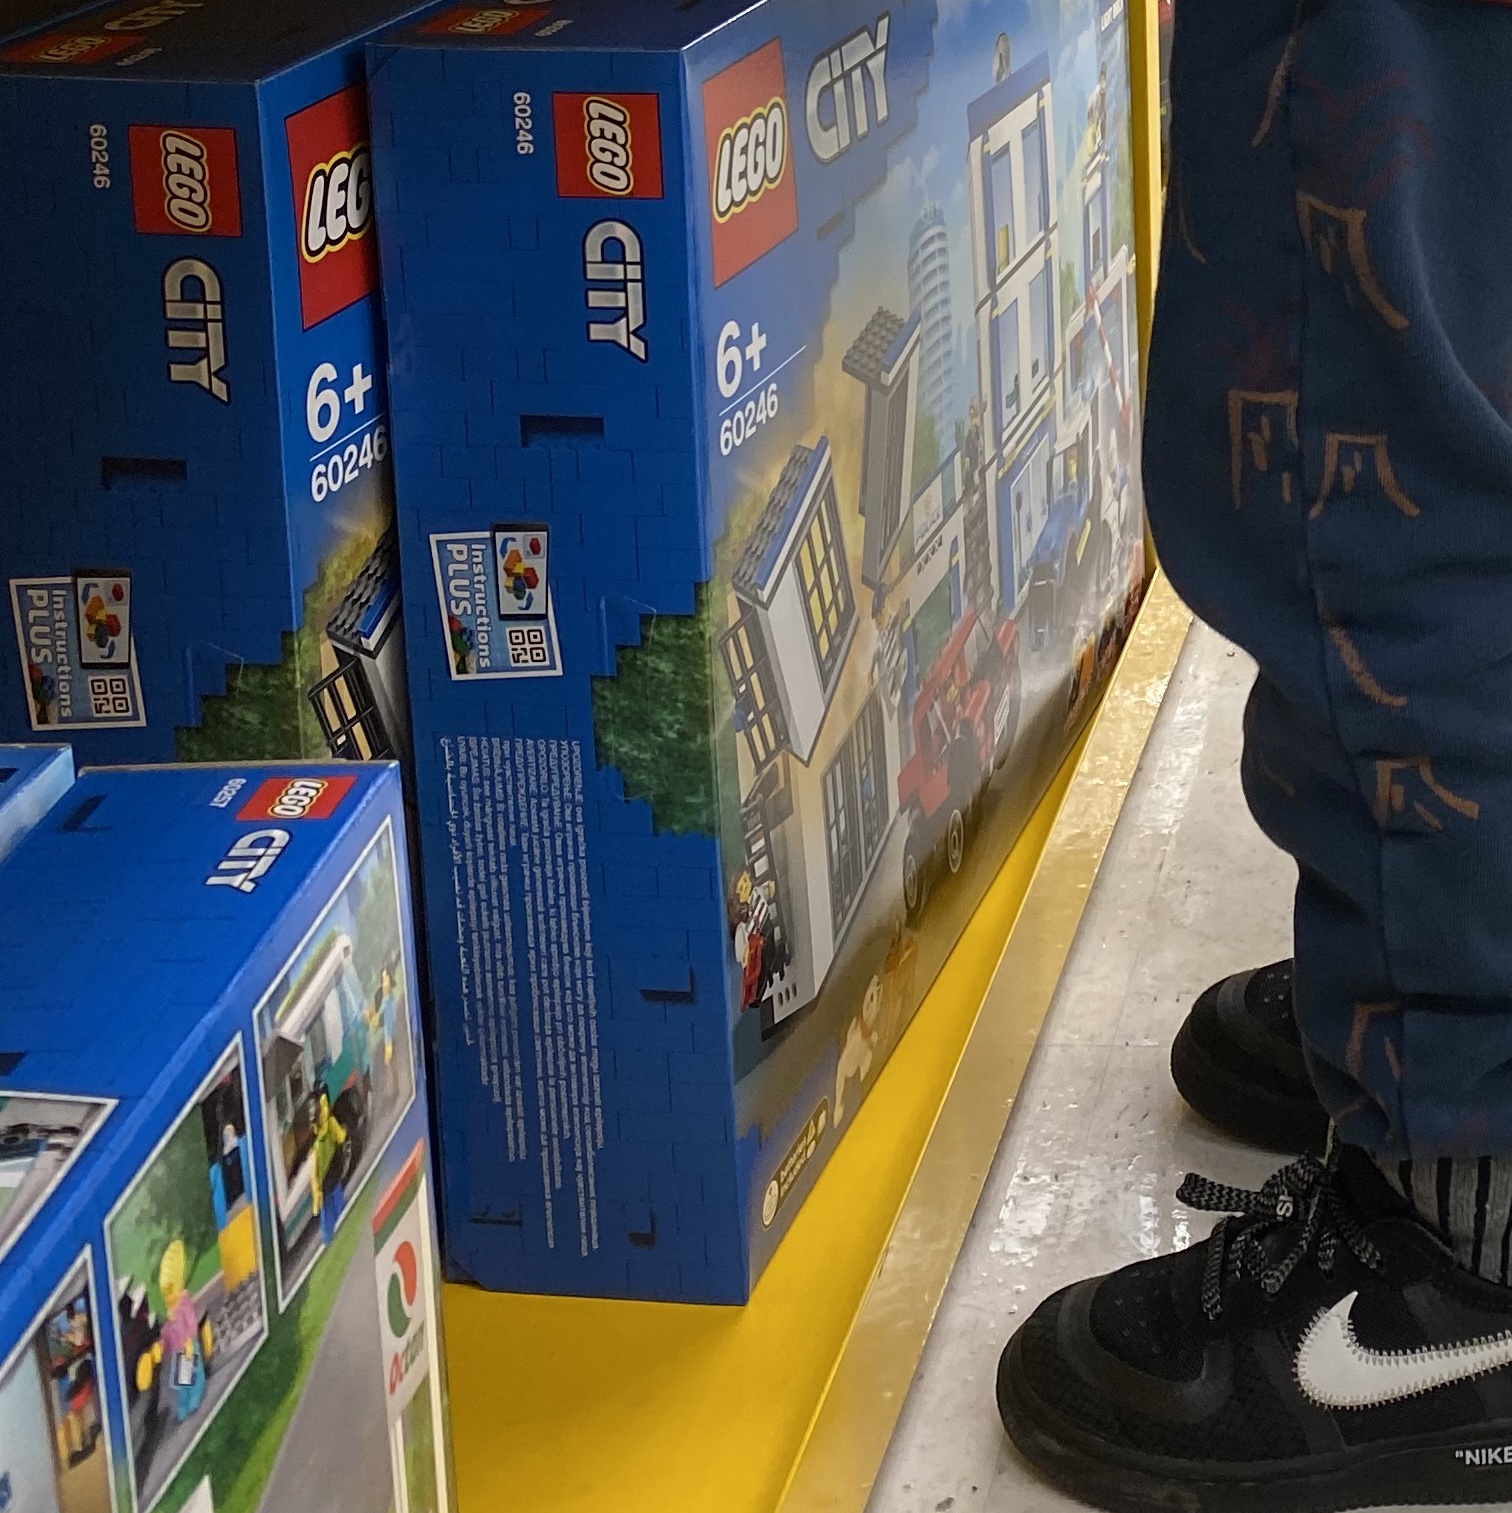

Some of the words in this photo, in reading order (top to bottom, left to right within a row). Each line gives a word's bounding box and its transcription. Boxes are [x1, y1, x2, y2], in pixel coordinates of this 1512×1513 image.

[455, 9, 515, 34] LEGO
[512, 91, 535, 156] 60246
[805, 13, 891, 164] CITY
[88, 123, 111, 189] 60246
[162, 131, 207, 231] LEGO
[584, 99, 630, 192] LEGO
[716, 102, 786, 218] LEGO
[307, 151, 372, 252] LEG
[583, 220, 649, 362] CITY
[163, 258, 232, 406] CITY
[716, 320, 767, 398] 6+
[306, 362, 373, 443] 6+
[720, 384, 779, 457] 60246
[310, 424, 388, 503] 60246
[446, 543, 472, 616] PLUS
[471, 543, 492, 668] Instructions
[26, 589, 53, 664] PLUS
[51, 589, 73, 718] Instructions
[271, 780, 325, 817] LEGO
[204, 828, 290, 893] CITY
